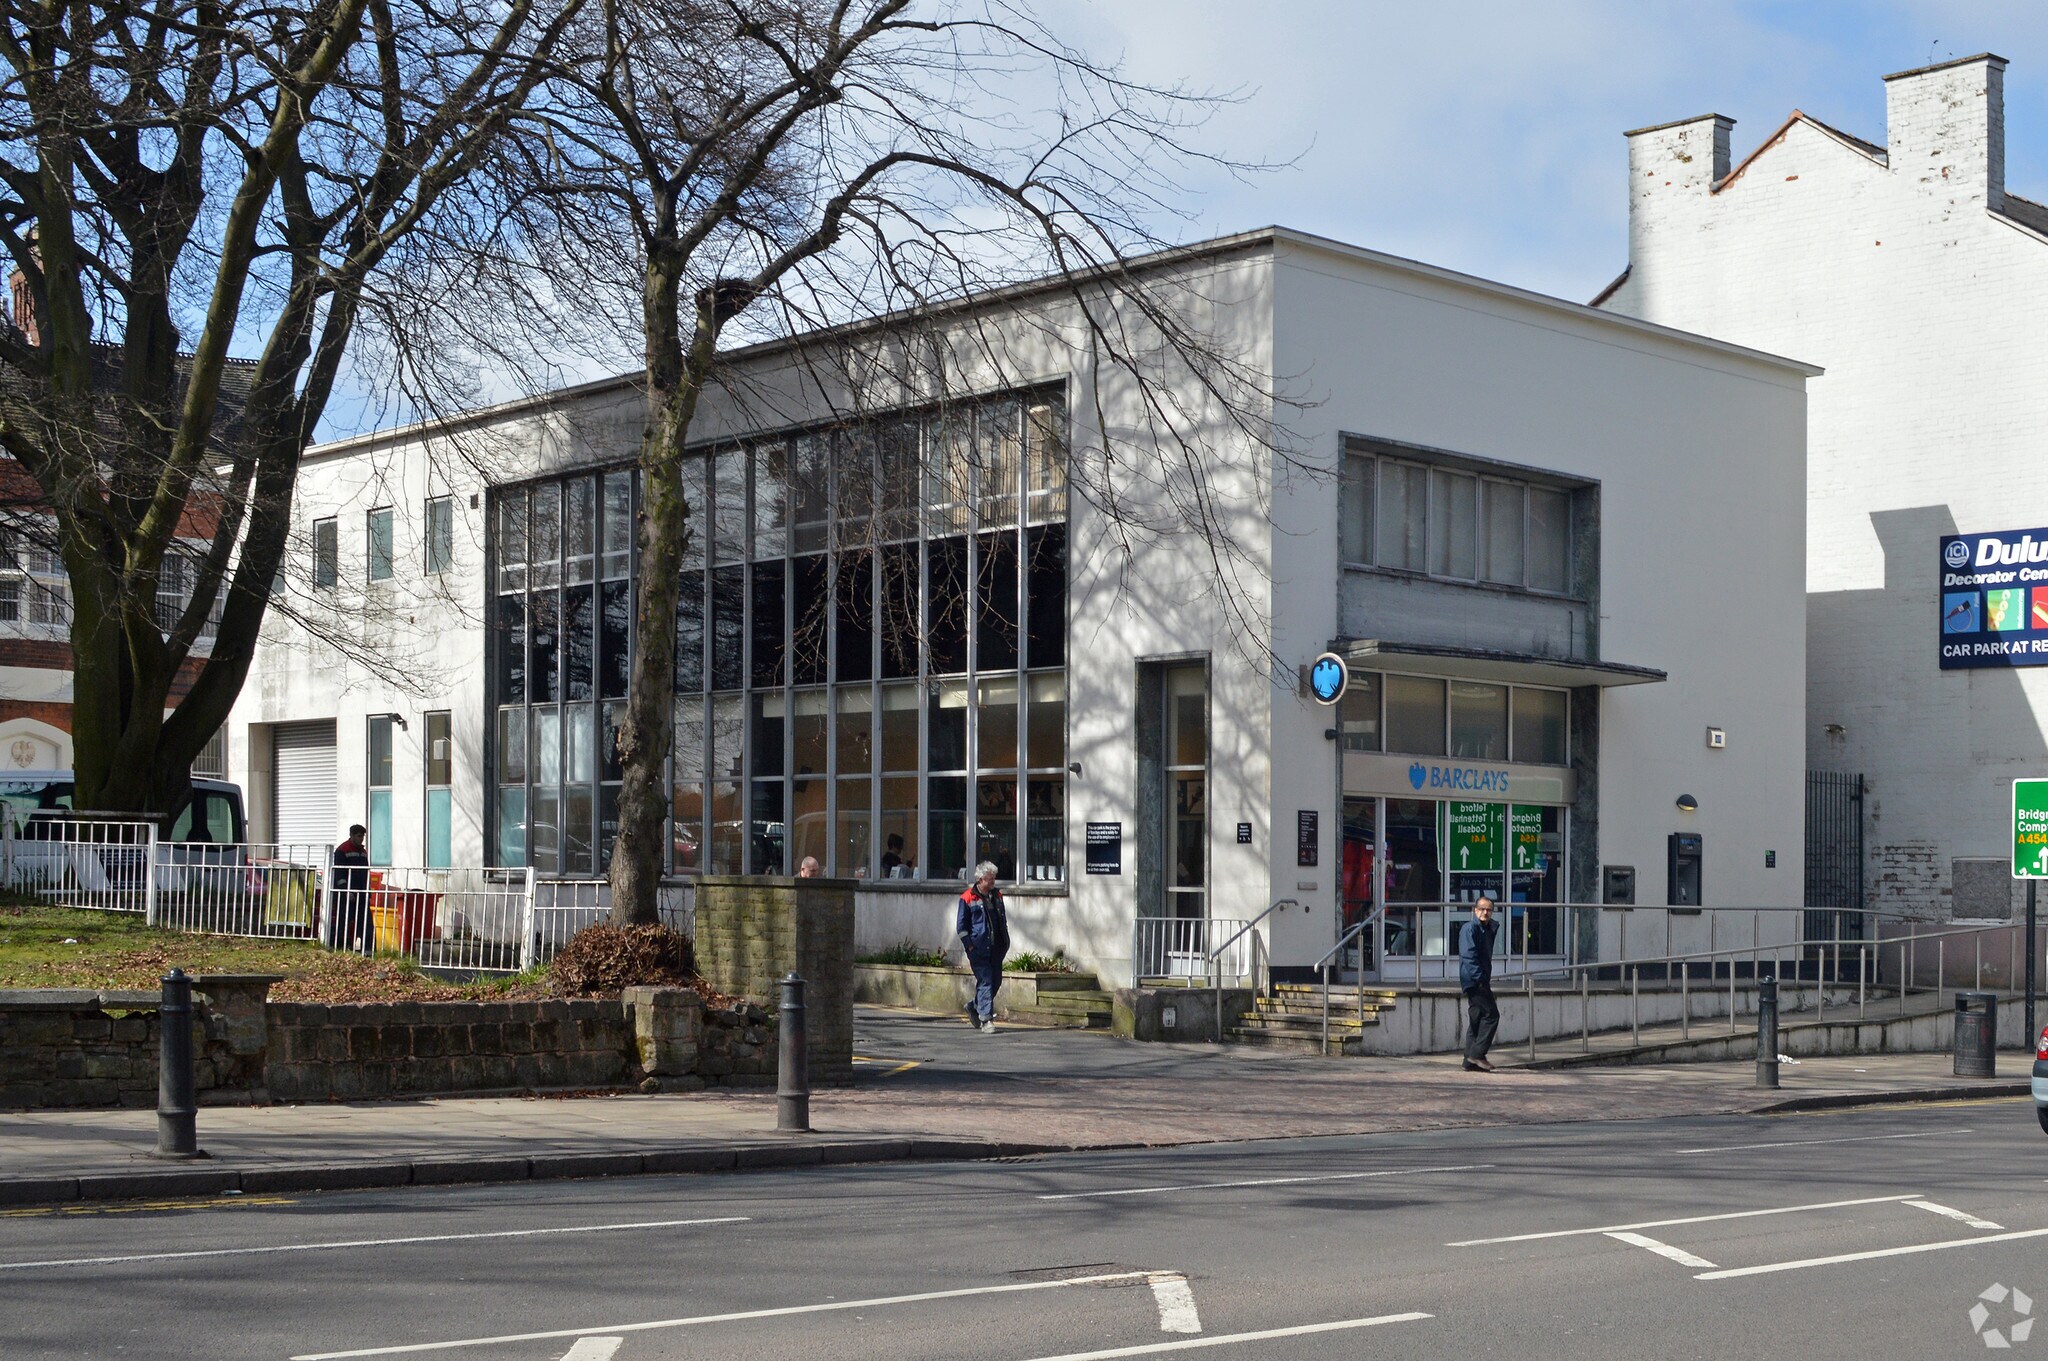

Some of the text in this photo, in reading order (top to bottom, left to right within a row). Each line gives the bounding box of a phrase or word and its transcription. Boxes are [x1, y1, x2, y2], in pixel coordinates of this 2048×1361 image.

[1974, 535, 2048, 567] Dulu
[1944, 570, 2016, 587] Decorator
[1943, 643, 1971, 657] CAR
[1974, 641, 2009, 656] PARK
[2012, 640, 2029, 654] AT
[1430, 766, 1509, 792] BARCLAYS
[2018, 822, 2048, 834] Comp
